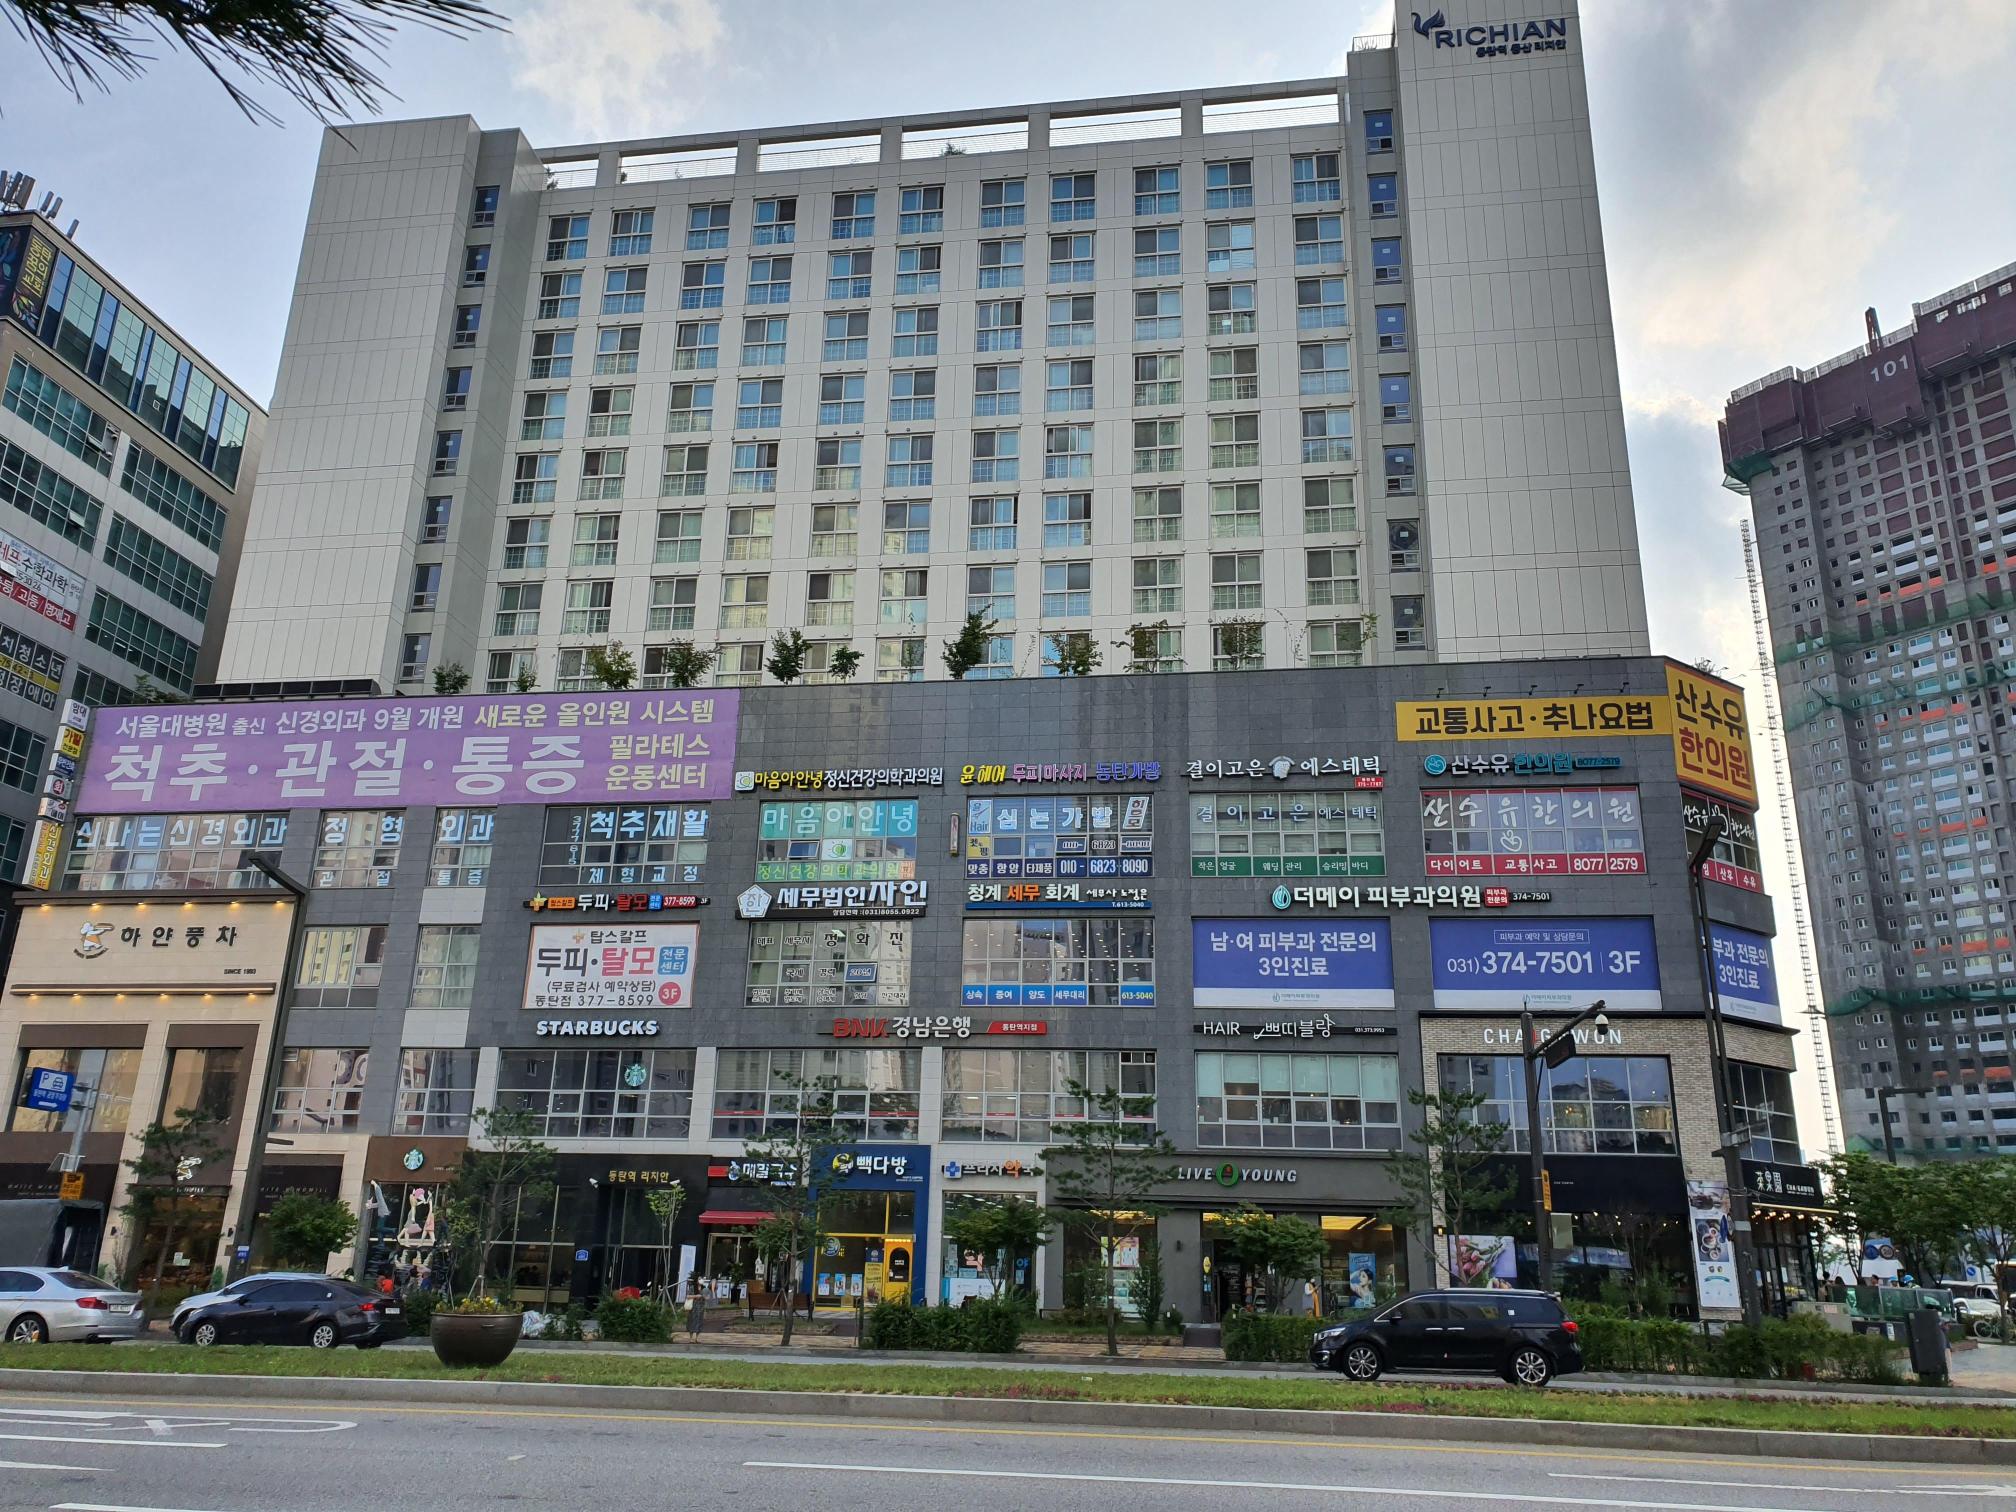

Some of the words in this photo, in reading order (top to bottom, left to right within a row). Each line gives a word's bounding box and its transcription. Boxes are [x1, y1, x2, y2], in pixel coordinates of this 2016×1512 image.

[1435, 18, 1566, 48] RICHIAN
[1870, 354, 1909, 382] 101
[116, 713, 227, 738] 서울대병원
[232, 717, 266, 735] 출신
[275, 709, 367, 734] 신경외과
[374, 707, 411, 730] 9월
[418, 706, 464, 730] 개원
[474, 703, 547, 728] 새로운
[557, 701, 630, 726] 올인원
[640, 699, 714, 724] 시스템
[1675, 680, 1744, 740] 산수유
[609, 734, 710, 760] 필라테스
[1187, 759, 1265, 779] 결이고은
[1300, 755, 1380, 776] 에스테틱
[1451, 753, 1510, 775] 산수유
[1514, 752, 1574, 774] 한의원
[1679, 726, 1752, 790] 한의원
[605, 763, 707, 791] 운동센터
[755, 769, 823, 788] 마음아안녕
[824, 767, 943, 787] 정신건강의학과의원
[1012, 763, 1087, 783] 두피마사지
[1096, 761, 1160, 781] 동탄가발
[590, 809, 708, 839] 척추재활
[763, 804, 914, 834] 마음아안녕
[970, 821, 989, 834] Hair
[1285, 861, 1302, 871] 관리
[1351, 861, 1369, 871] 바디
[1430, 858, 1484, 871] 다이어트
[1504, 858, 1558, 870] 교통사고
[663, 895, 696, 906] 377-8599
[968, 883, 1001, 902] 청계
[1007, 883, 1041, 901] 세무
[1045, 883, 1080, 901] 회계
[1086, 888, 1117, 898] 세무사
[1294, 885, 1360, 908] 더메이
[1367, 884, 1481, 909] 피부과의원
[1513, 891, 1551, 901] 374-7501
[590, 930, 648, 944] 탑스칼프
[1258, 931, 1316, 953] 피부과
[1319, 931, 1377, 953] 전문의
[1499, 932, 1523, 941] 피부과
[1524, 932, 1541, 941] 예약
[662, 948, 687, 960] 전문
[1447, 956, 1480, 975] 031)
[1482, 950, 1594, 974] 374-7501
[1608, 950, 1641, 974] 3F
[1736, 943, 1770, 969] 전문의
[660, 961, 685, 973] 센터
[1258, 956, 1330, 977] 3인진료
[1719, 964, 1761, 990] 3인진료
[547, 982, 600, 994] (무료검사
[604, 980, 657, 993] 예약상담)
[662, 988, 679, 1000] 3F
[1028, 989, 1046, 1000] 양도
[1054, 988, 1086, 1000] 세무대리
[1121, 991, 1154, 1000] 613-5040
[535, 995, 572, 1007] 동탄점
[536, 1020, 659, 1036] STARBUCKS
[834, 1017, 889, 1038] BNK
[893, 1015, 971, 1038] 경남은행
[1202, 1021, 1242, 1036] HAIR
[856, 1155, 908, 1176] 빽다방
[1178, 1167, 1213, 1180] LIVE
[1241, 1168, 1298, 1182] YOUNG
[608, 1170, 636, 1182] 동탄역
[640, 1171, 670, 1183] 리지안
